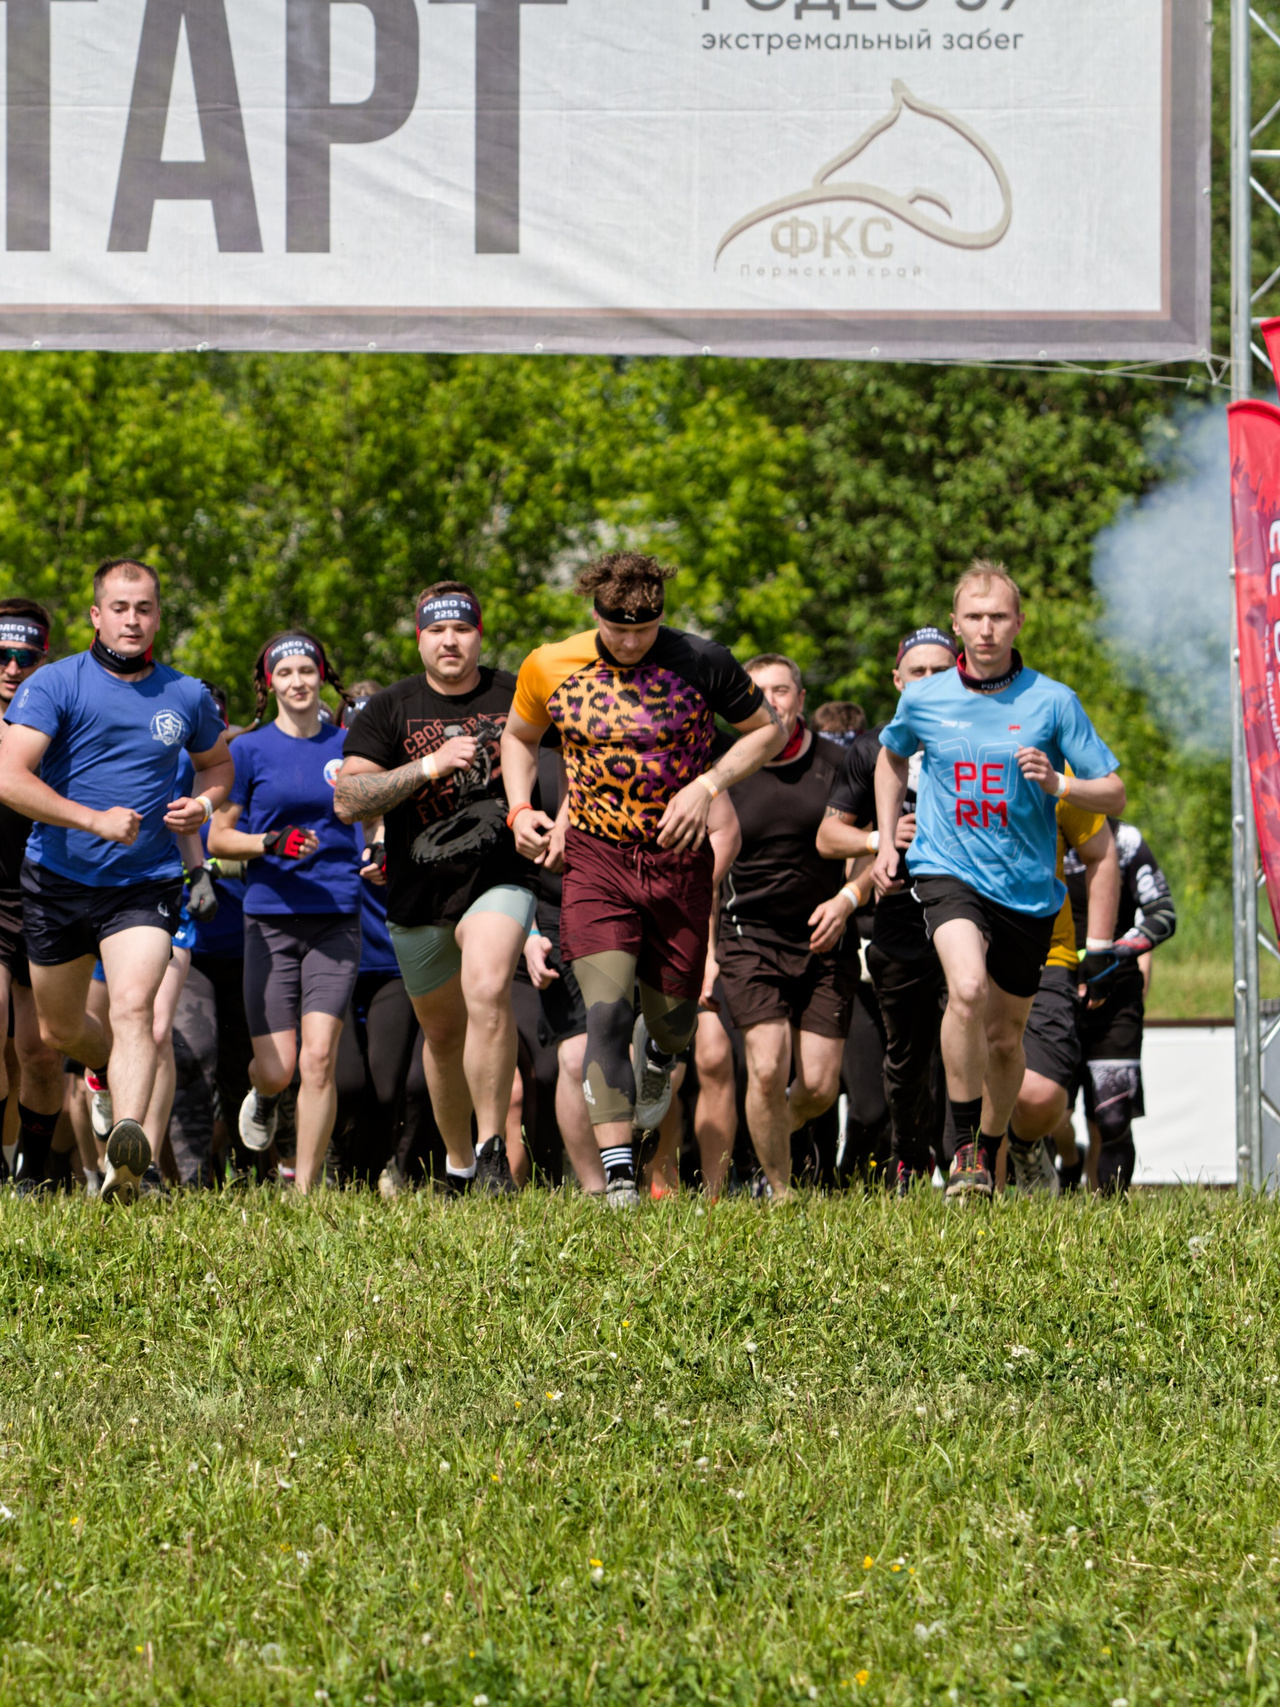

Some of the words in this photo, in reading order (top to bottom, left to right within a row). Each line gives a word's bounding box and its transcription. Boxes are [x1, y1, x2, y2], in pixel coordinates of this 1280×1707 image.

[701, 28, 932, 54] экстремальный
[942, 27, 1024, 50] забег
[770, 216, 893, 259] ФКС
[740, 263, 856, 278] Пермский
[867, 264, 923, 279] край
[423, 599, 458, 614] РОДЕО
[434, 609, 460, 620] 2255
[954, 761, 1004, 794] PE
[955, 797, 1008, 828] RM
